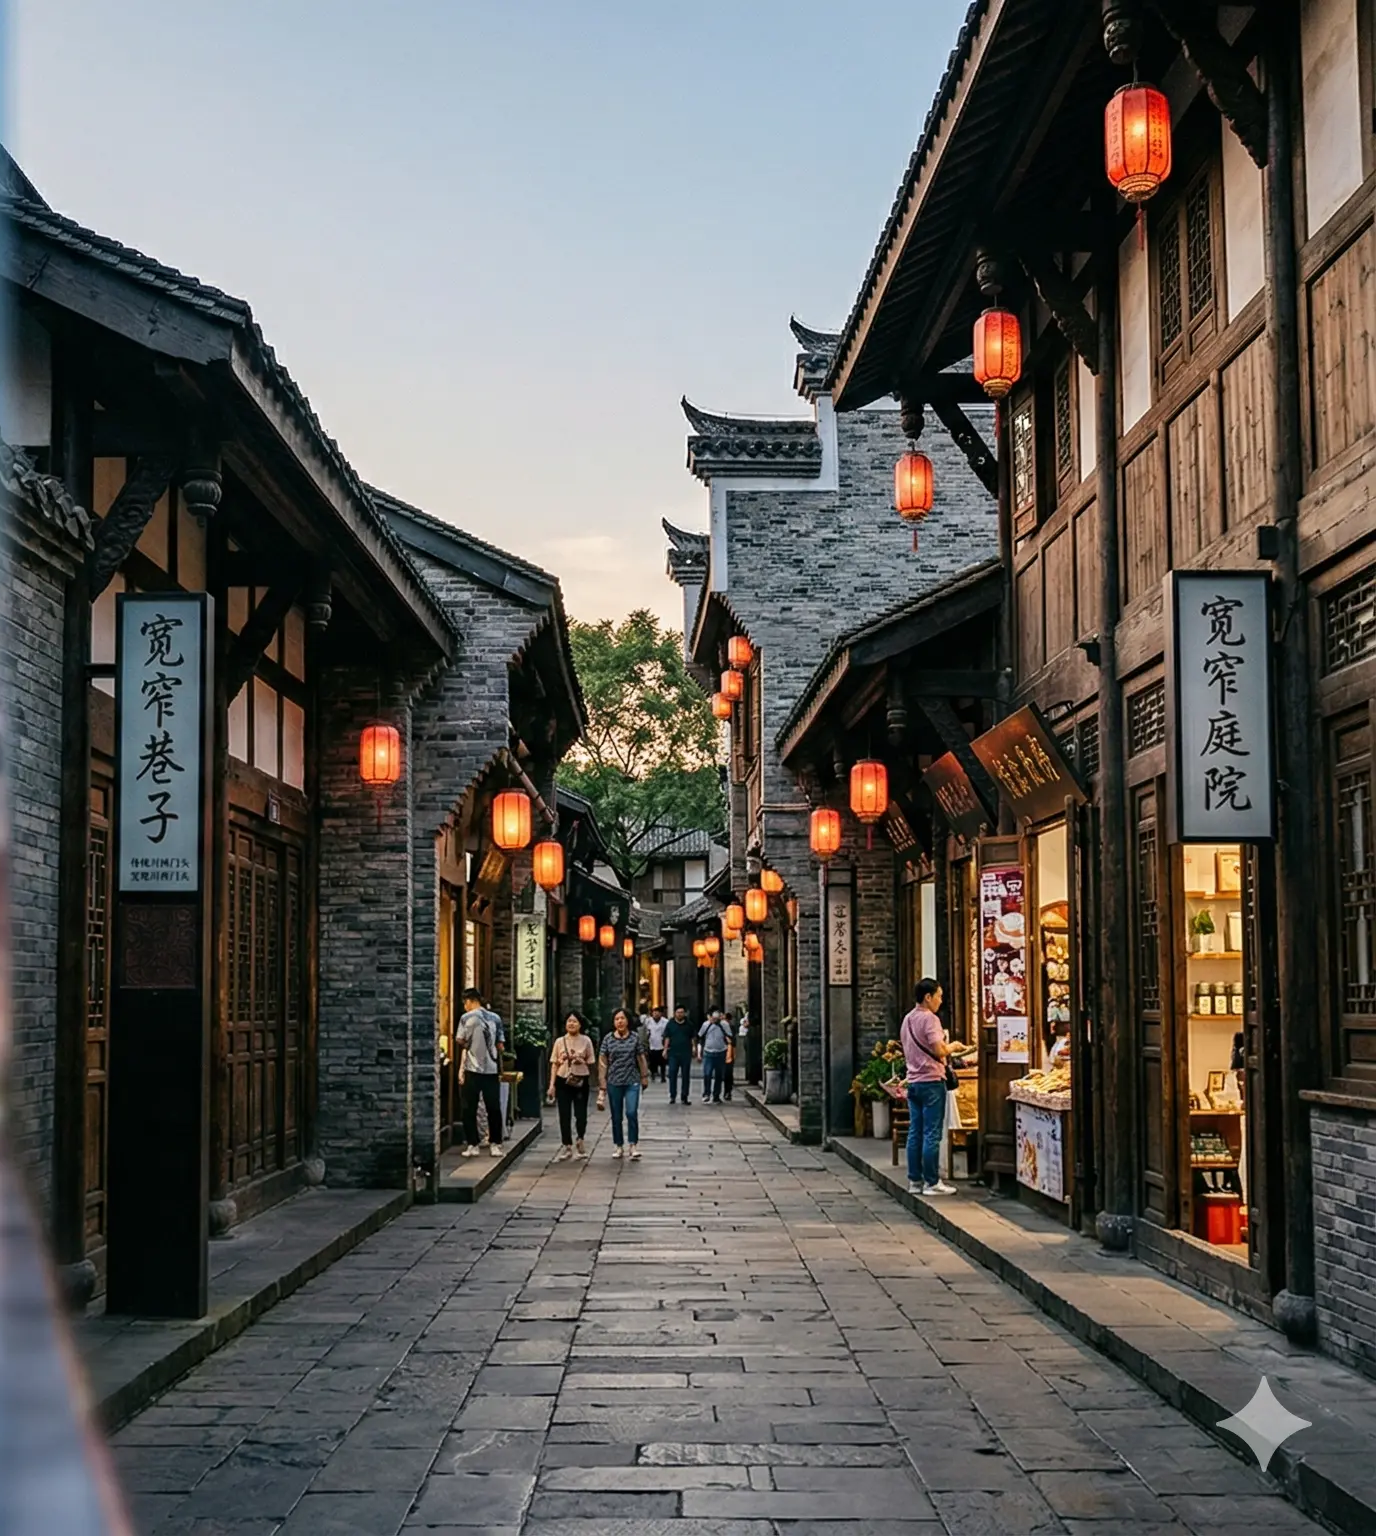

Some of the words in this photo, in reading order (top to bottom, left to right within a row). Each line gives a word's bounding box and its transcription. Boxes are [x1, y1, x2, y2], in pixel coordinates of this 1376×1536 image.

[135, 613, 186, 844] 宽窄巷子
[1200, 595, 1252, 811] 宽窄庭院
